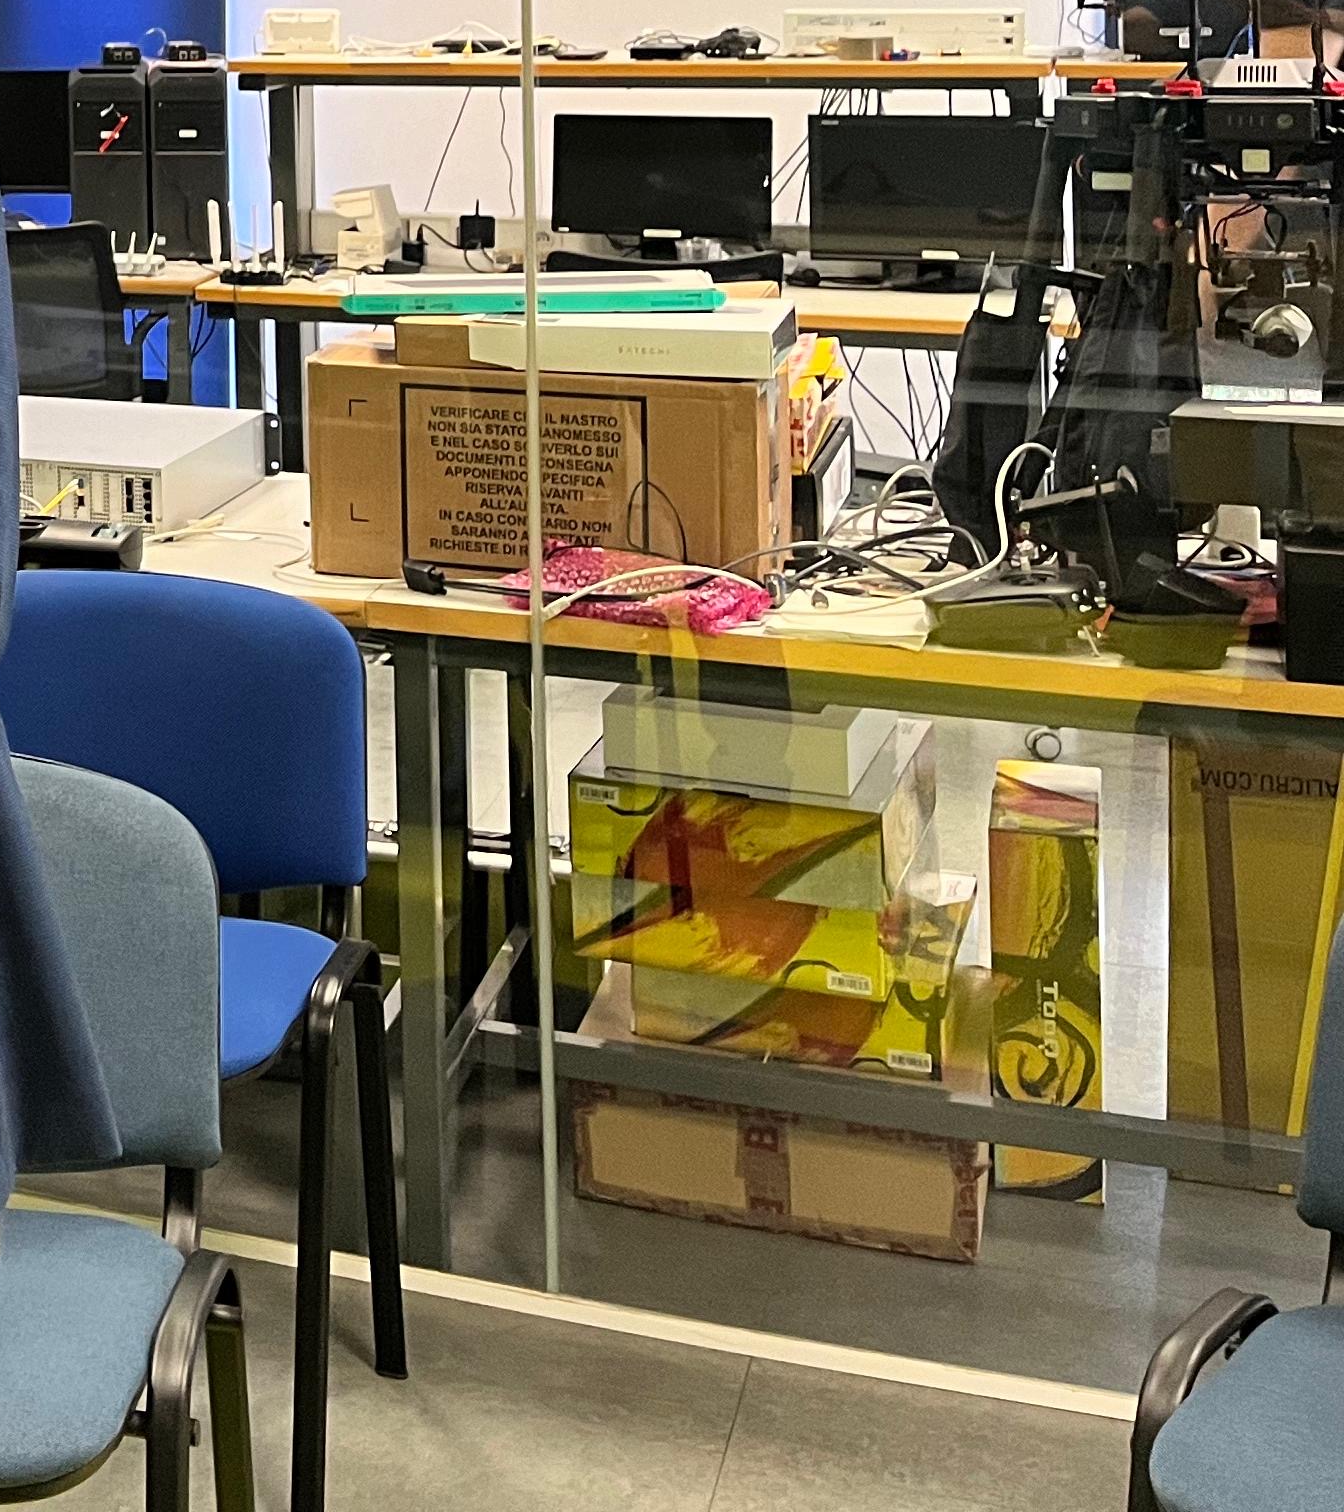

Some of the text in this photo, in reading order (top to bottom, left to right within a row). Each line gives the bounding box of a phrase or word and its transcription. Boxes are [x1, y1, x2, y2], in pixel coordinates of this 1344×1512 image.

[431, 406, 509, 422] VERIFICARE
[545, 413, 557, 423] IL
[561, 414, 618, 427] NASTRO
[427, 421, 456, 433] NON
[461, 422, 482, 433] SIA
[485, 424, 527, 436] STATO
[431, 436, 439, 446] E
[443, 437, 468, 448] NEL
[472, 438, 510, 451] CASO
[436, 451, 515, 466] DOCUMENTI
[444, 466, 606, 488] APPONENDO PECIFICA
[465, 481, 522, 497] RISERVA
[439, 509, 611, 534] IN CASO CONARIO NON
[451, 525, 517, 540] SARANNO
[429, 538, 499, 554] RICHIESTE
[503, 544, 516, 555] DI
